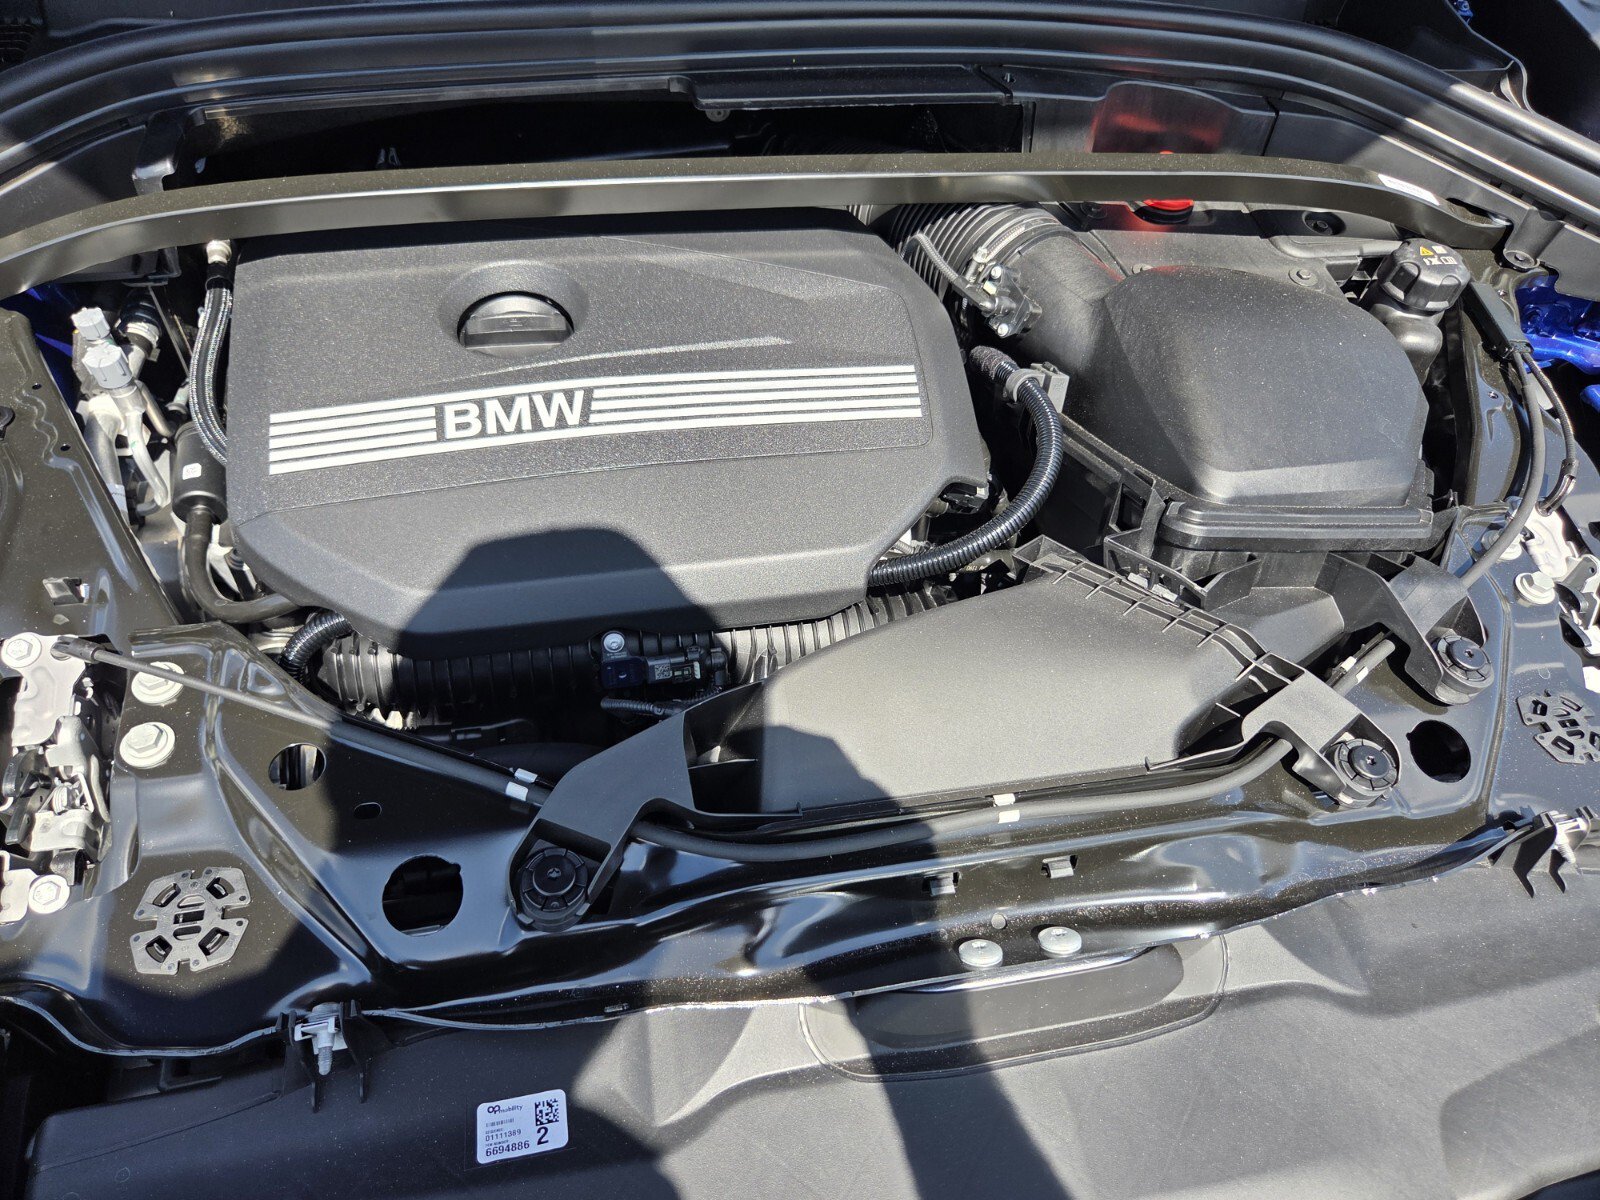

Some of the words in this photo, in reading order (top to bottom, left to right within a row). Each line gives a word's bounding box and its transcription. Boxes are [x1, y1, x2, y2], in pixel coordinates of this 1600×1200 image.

[444, 390, 585, 440] BMW
[485, 1128, 522, 1142] 01111389
[536, 1126, 549, 1146] 2
[485, 1140, 530, 1157] 6694886
